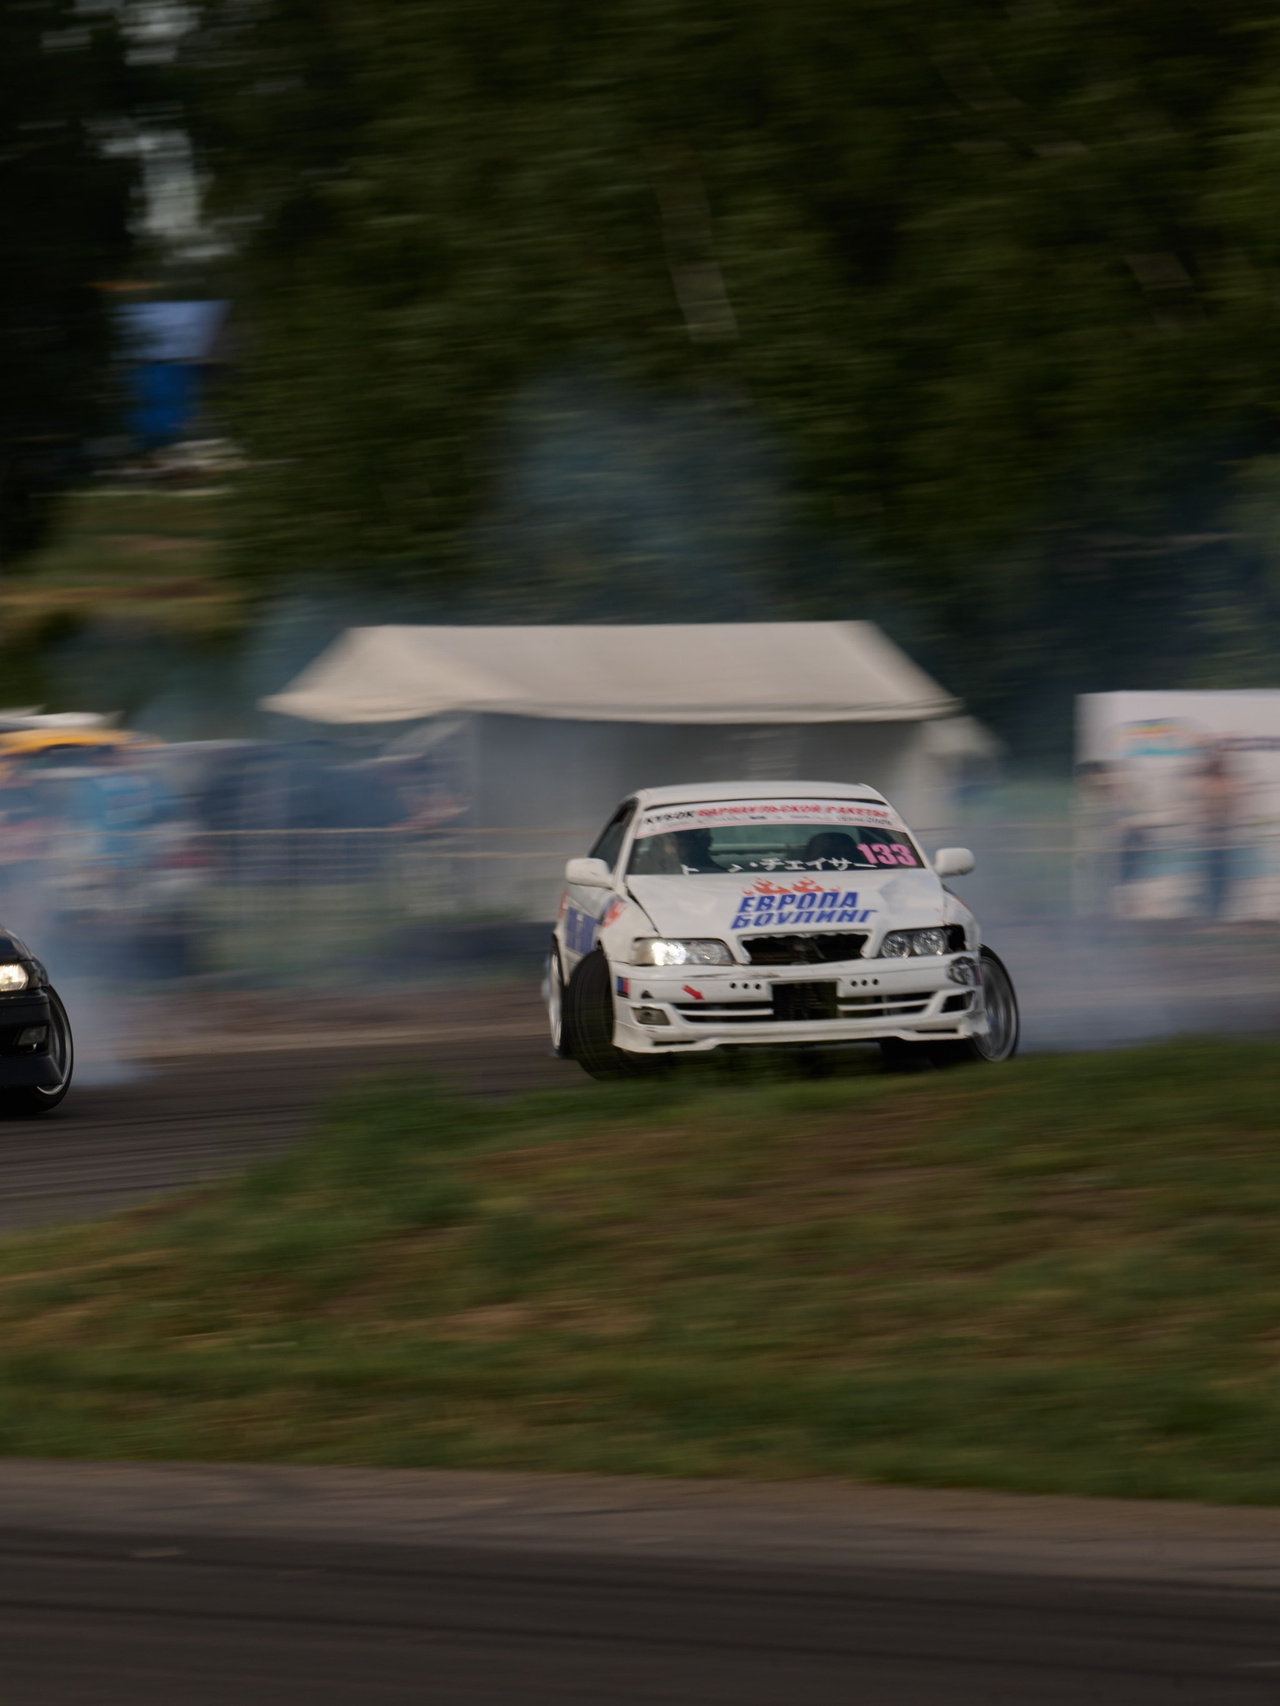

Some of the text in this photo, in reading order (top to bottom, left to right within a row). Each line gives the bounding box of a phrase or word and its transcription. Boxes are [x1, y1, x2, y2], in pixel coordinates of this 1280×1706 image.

[856, 842, 917, 867] 133
[737, 891, 859, 914] ЕВРОПА
[730, 909, 879, 930] БОУЛИНГ
